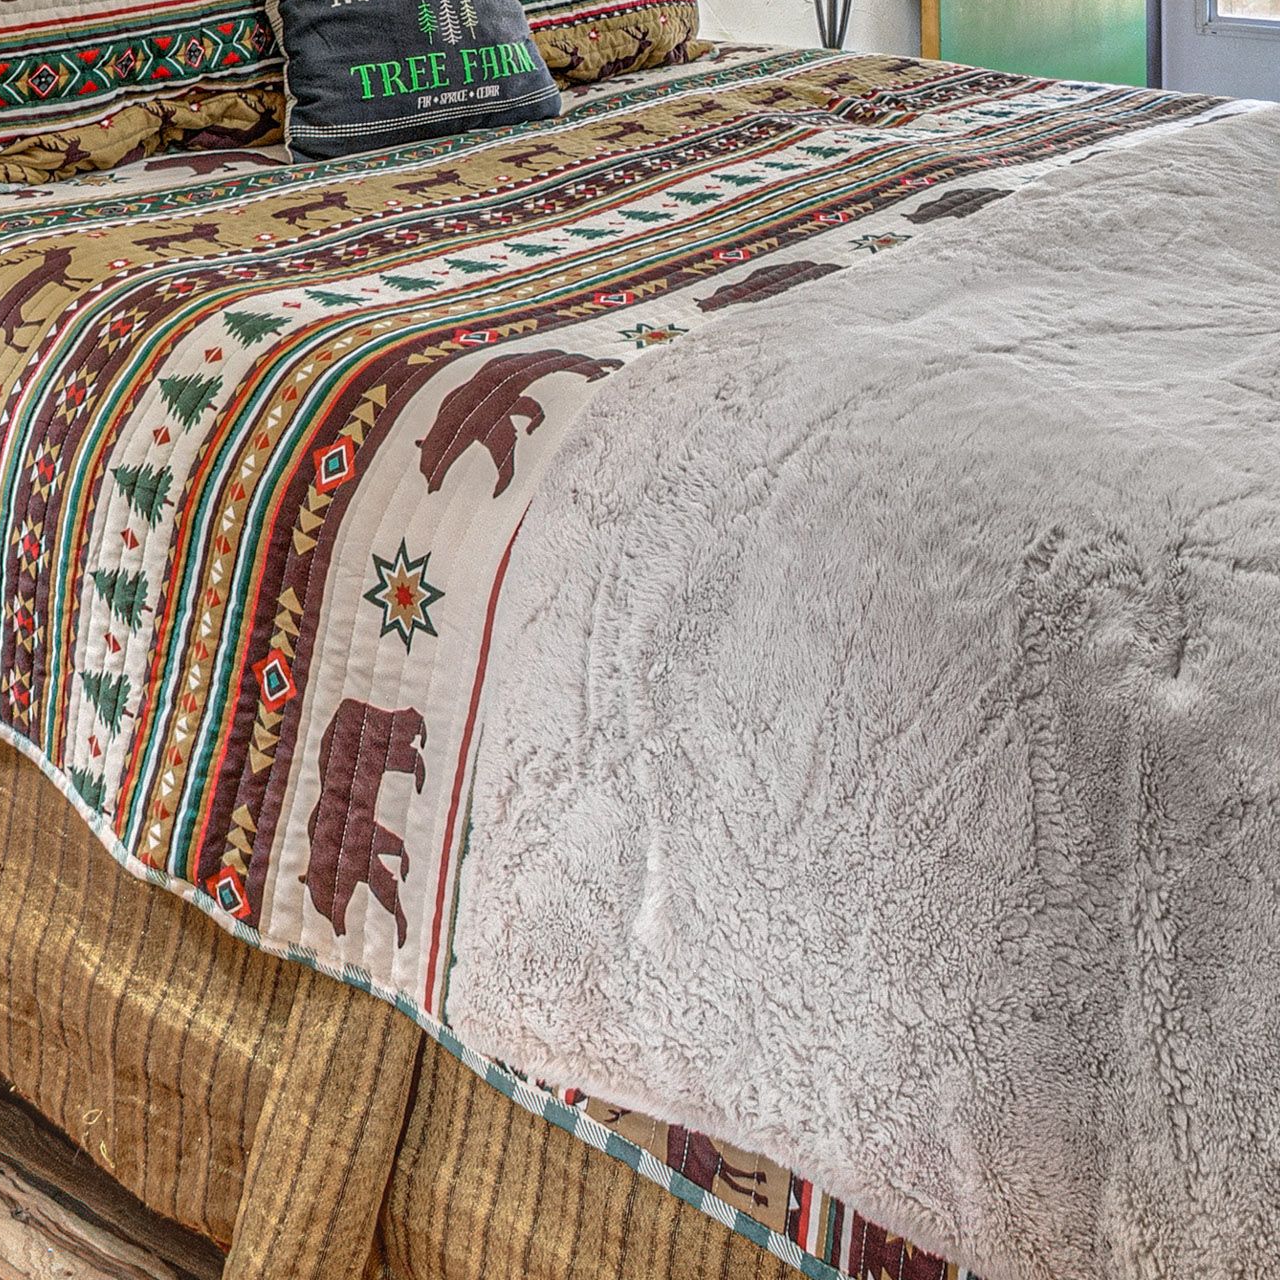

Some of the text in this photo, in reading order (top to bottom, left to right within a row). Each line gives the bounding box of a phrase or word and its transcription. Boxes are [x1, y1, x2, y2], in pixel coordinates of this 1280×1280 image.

[350, 42, 538, 100] TREE FARM
[417, 85, 500, 109] FIR SPRUCE CEDAR
